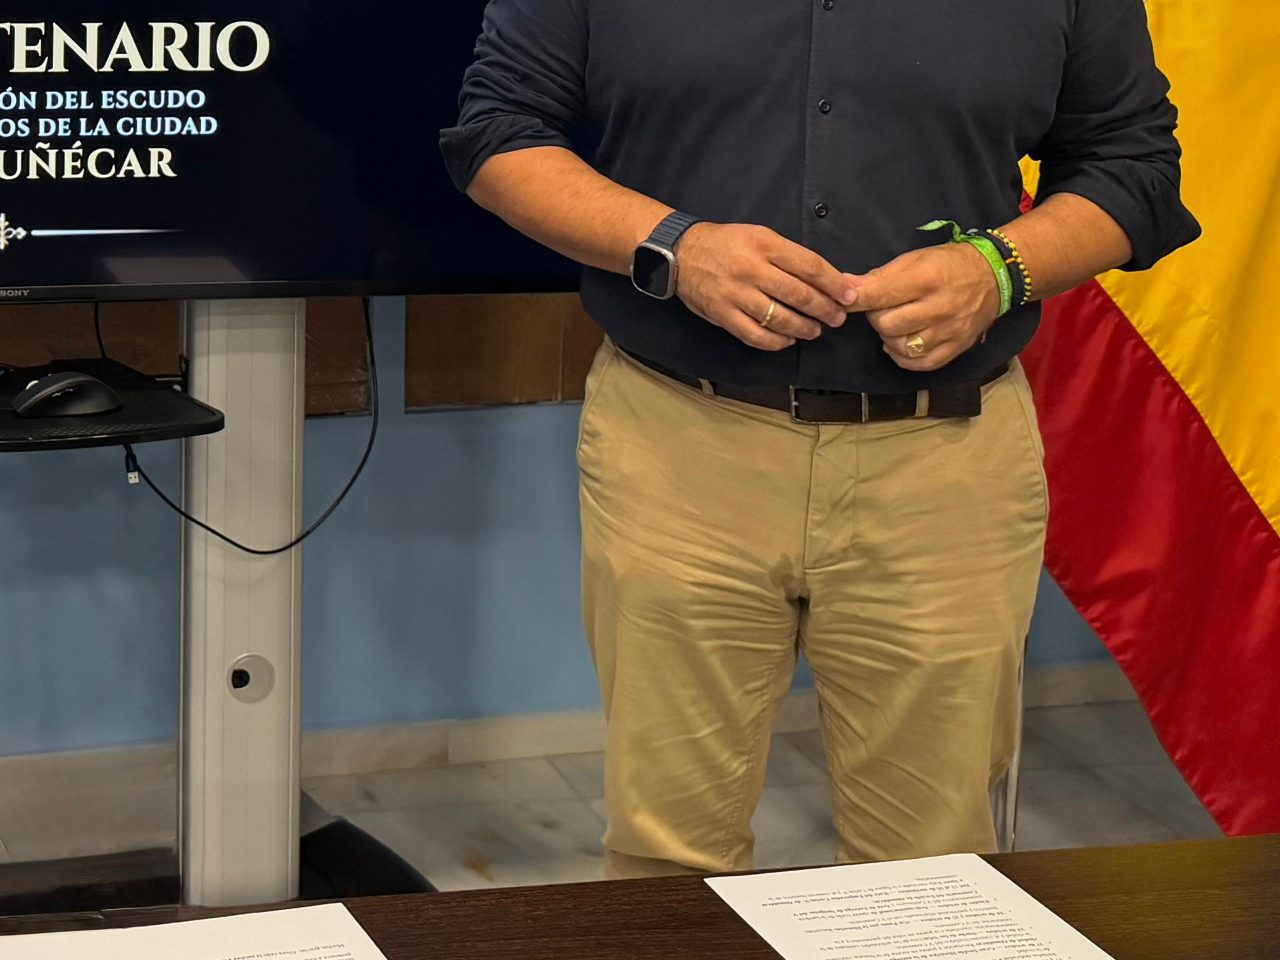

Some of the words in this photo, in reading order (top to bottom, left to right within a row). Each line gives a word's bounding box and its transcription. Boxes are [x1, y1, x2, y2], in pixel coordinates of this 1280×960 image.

[46, 91, 93, 110] DEL
[101, 90, 205, 109] ESCUDO
[38, 118, 71, 136] DE
[79, 117, 111, 136] LA
[117, 116, 217, 136] CIUDAD
